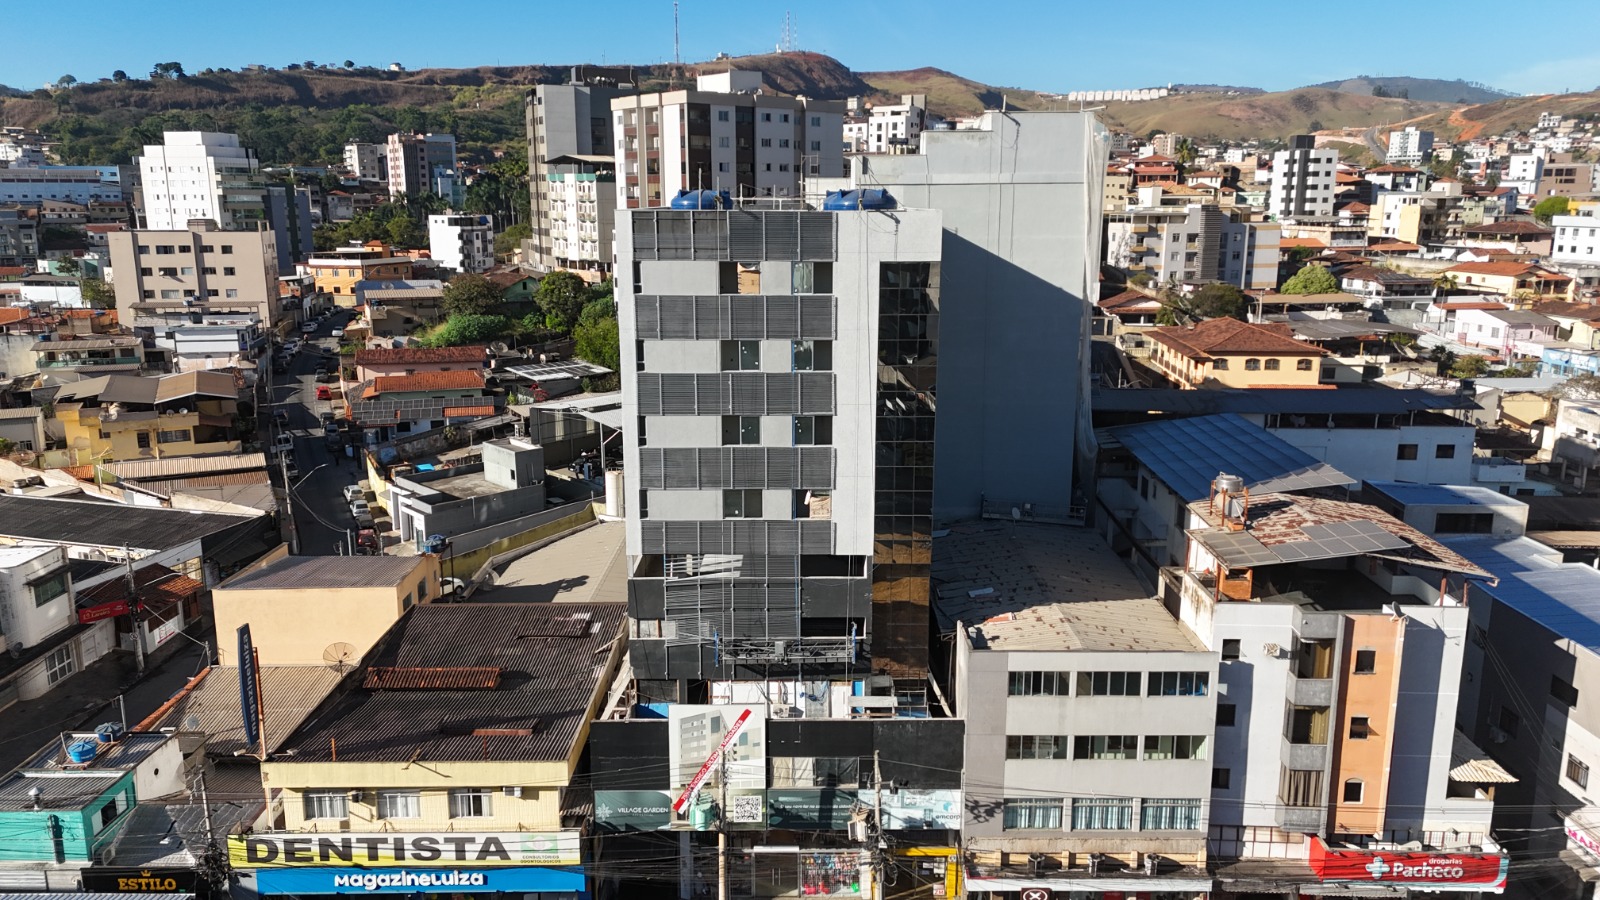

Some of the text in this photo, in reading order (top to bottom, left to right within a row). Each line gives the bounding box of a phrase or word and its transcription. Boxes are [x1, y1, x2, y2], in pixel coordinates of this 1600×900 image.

[243, 633, 257, 736] magazineluiza
[246, 836, 512, 863] DENTISTA
[1392, 862, 1464, 879] Pacheco
[118, 878, 177, 891] ESTILO
